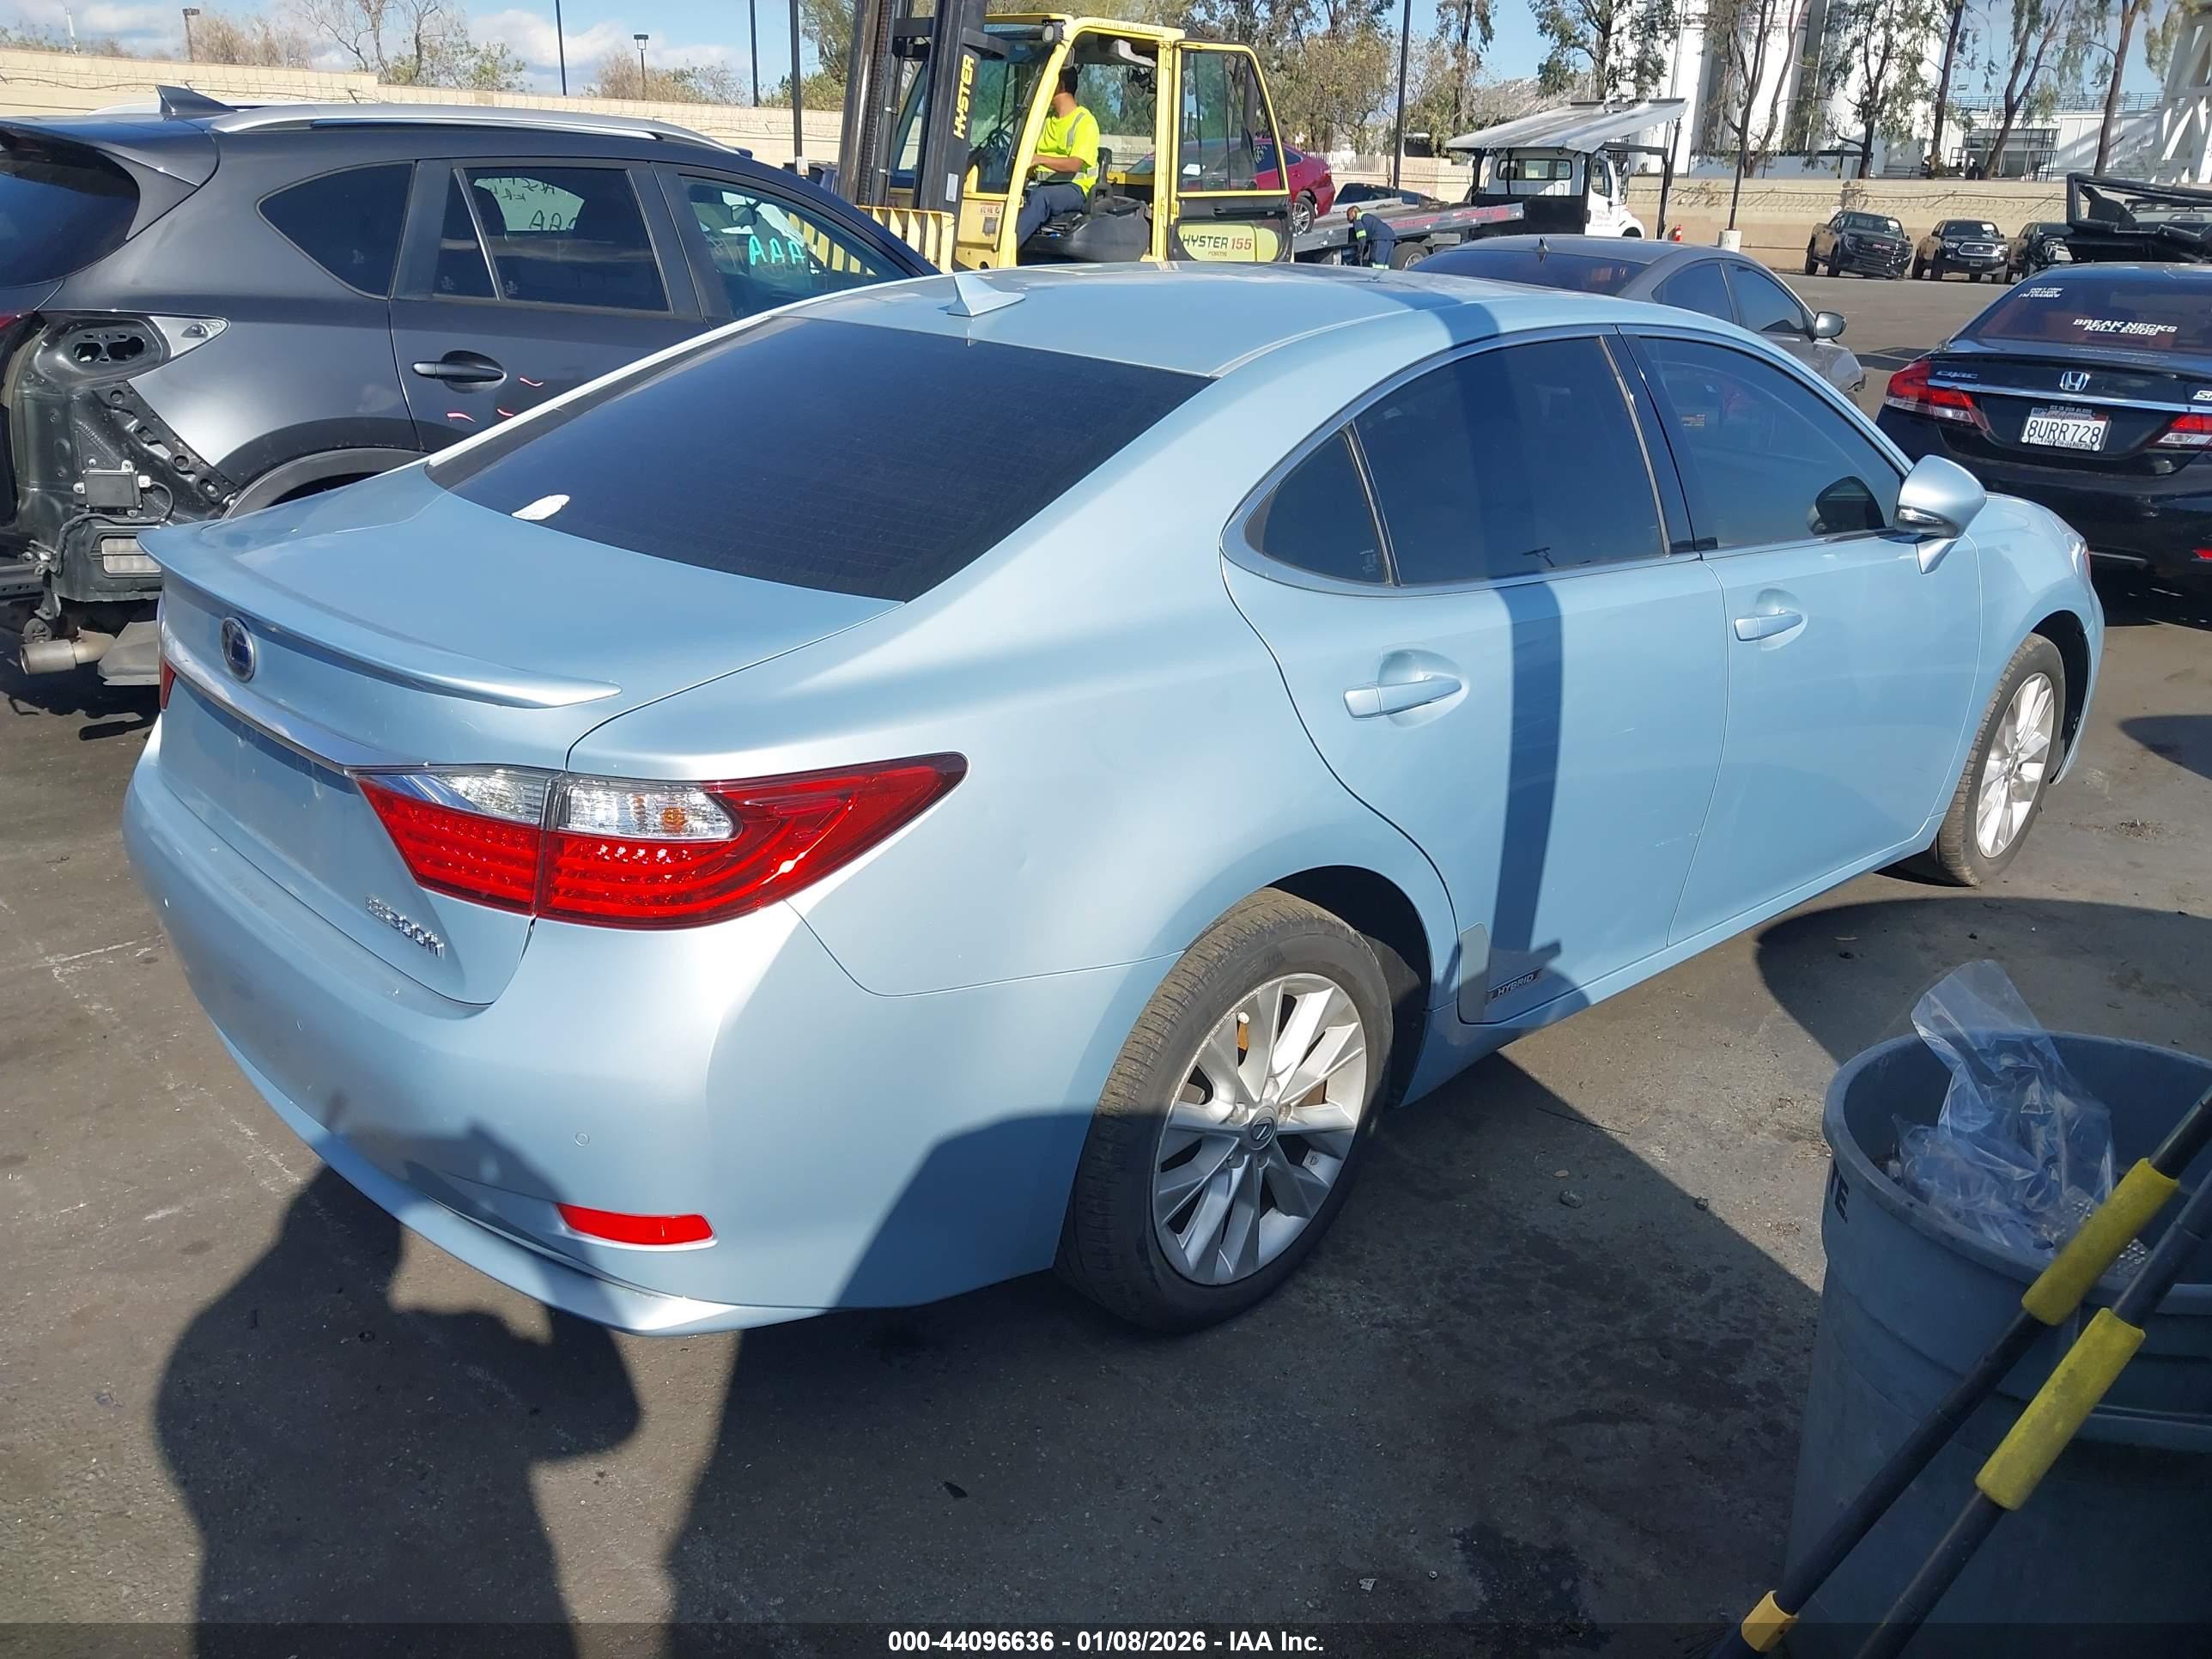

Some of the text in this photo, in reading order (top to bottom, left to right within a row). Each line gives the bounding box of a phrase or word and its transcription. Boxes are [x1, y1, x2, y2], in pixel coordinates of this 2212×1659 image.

[953, 54, 975, 139] HYSTER
[748, 234, 806, 266] AAA
[1182, 234, 1253, 251] HYSTER 155
[2073, 319, 2179, 333] BREAK NECKS
[2027, 419, 2102, 445] 8URR728
[1497, 974, 1534, 996] HYBRID
